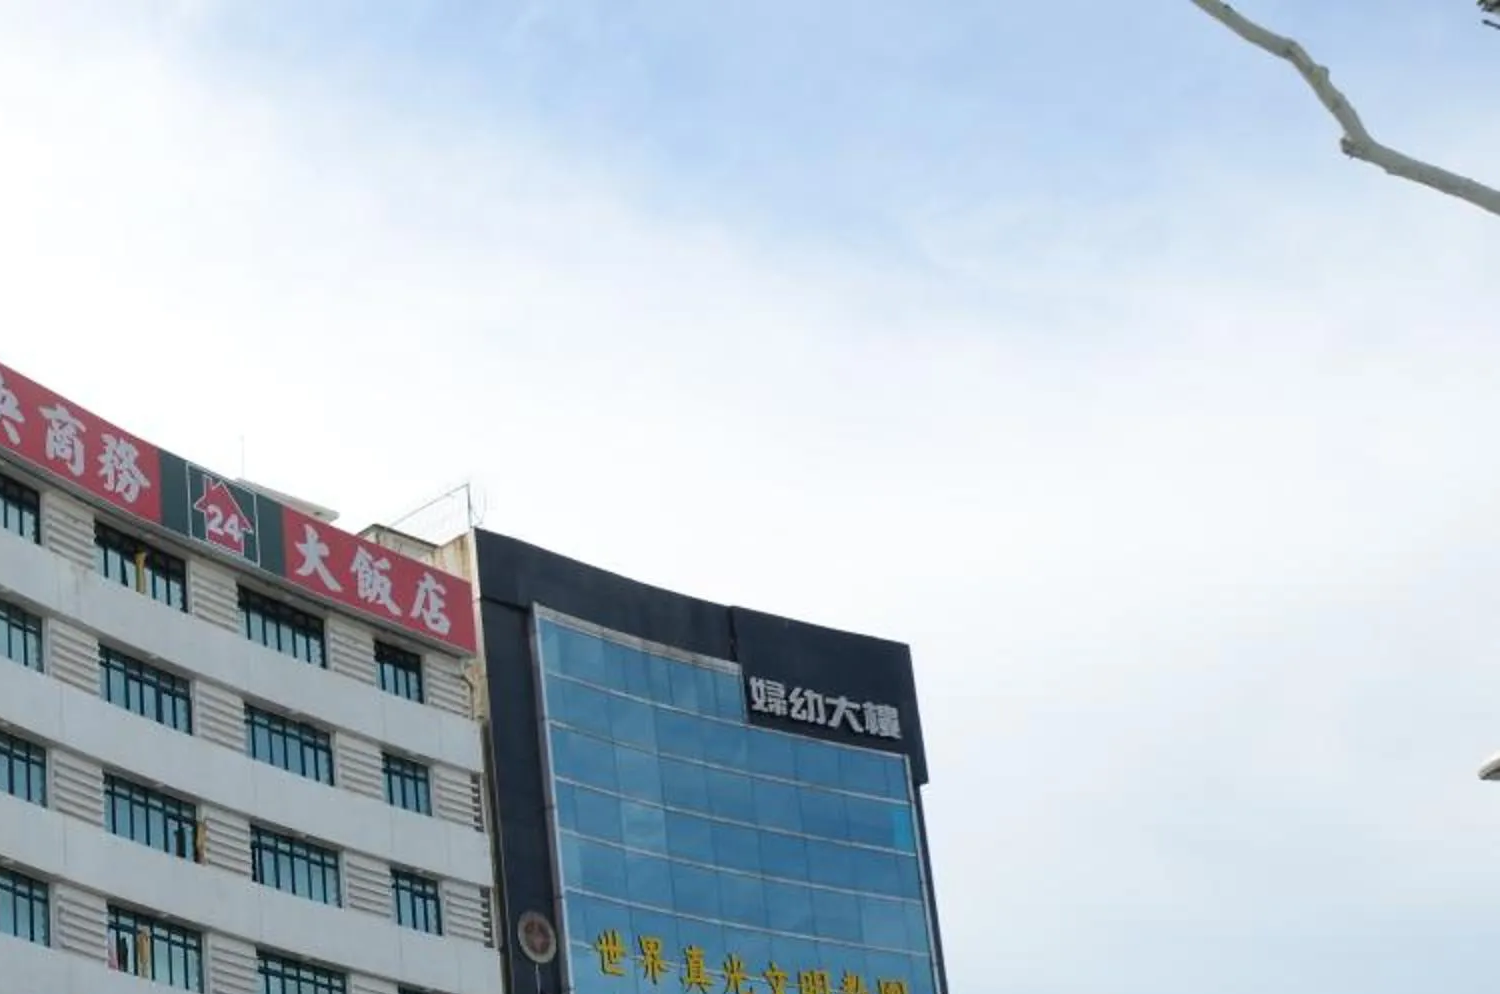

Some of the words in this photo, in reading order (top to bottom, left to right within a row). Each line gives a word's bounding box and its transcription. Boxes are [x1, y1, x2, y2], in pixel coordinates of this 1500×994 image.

[207, 503, 242, 544] 24
[296, 524, 451, 636] 大飯店
[749, 677, 902, 739] 婦幼大樓
